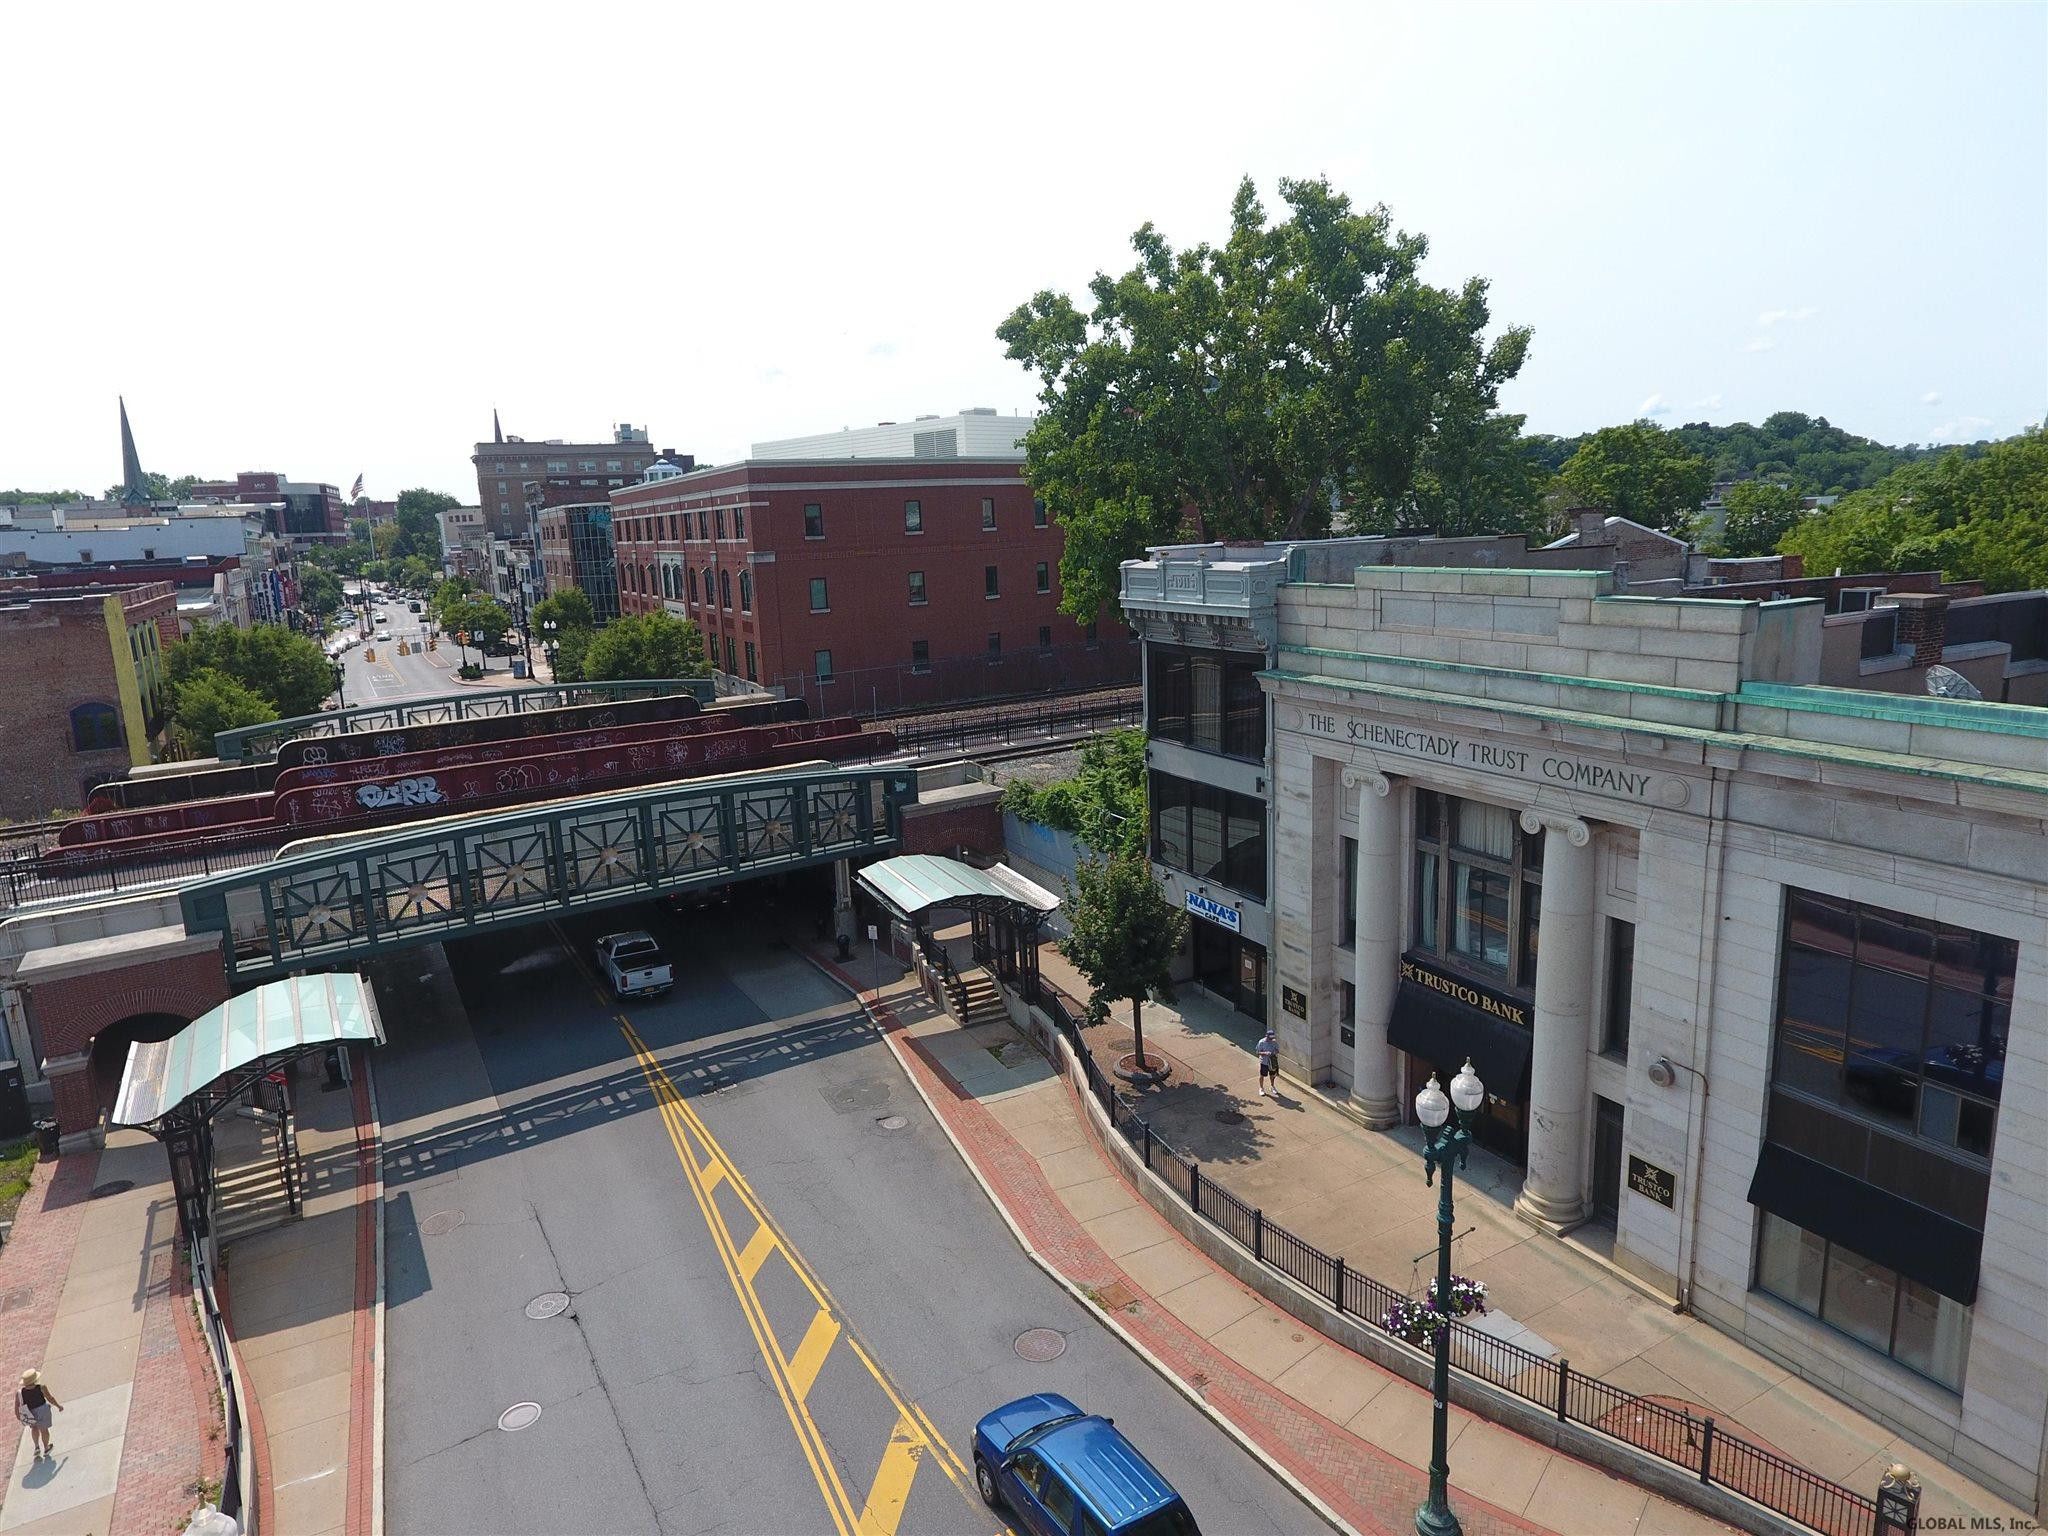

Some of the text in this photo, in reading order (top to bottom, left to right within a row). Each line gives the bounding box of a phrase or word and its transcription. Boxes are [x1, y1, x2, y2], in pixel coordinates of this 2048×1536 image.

[1308, 713, 1651, 797] THE SCHENECTADY TRUST COMPANY
[1188, 893, 1237, 923] NANA'S
[1415, 968, 1525, 1025] TRUSTCO BANK
[1632, 1172, 1670, 1197] TRUSTCO
[1638, 1184, 1662, 1201] BANK
